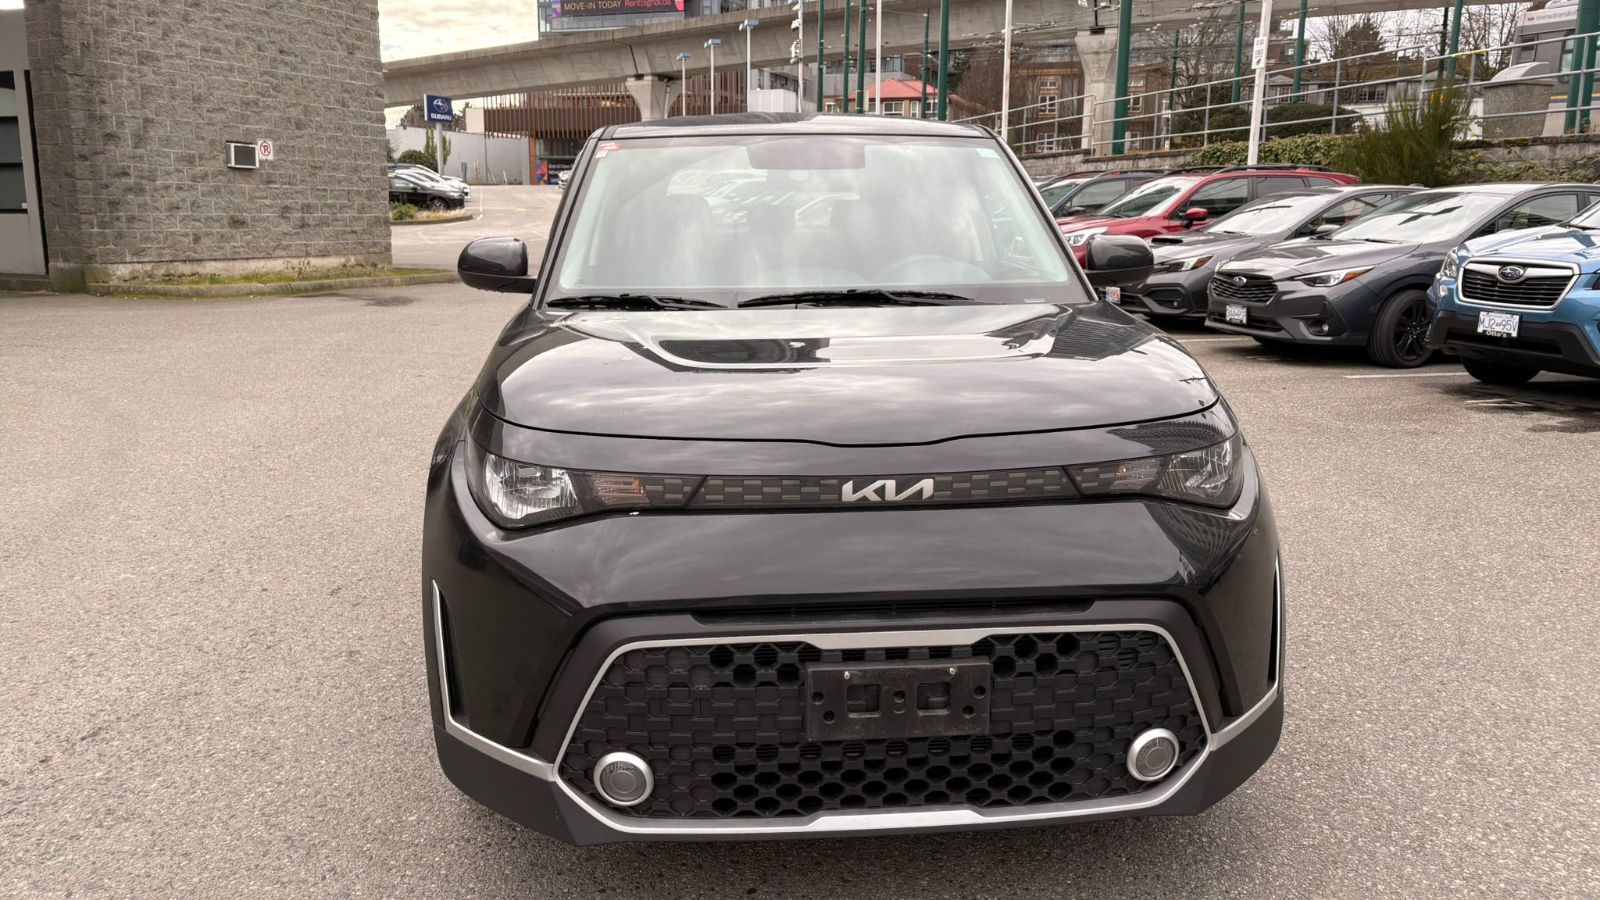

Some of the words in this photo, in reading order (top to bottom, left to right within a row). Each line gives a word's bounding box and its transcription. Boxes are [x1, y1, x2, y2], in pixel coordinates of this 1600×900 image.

[564, 2, 596, 11] MOVE-IN
[598, 0, 621, 9] TODAY
[430, 112, 452, 121] SUBARU
[841, 478, 934, 502] KIA
